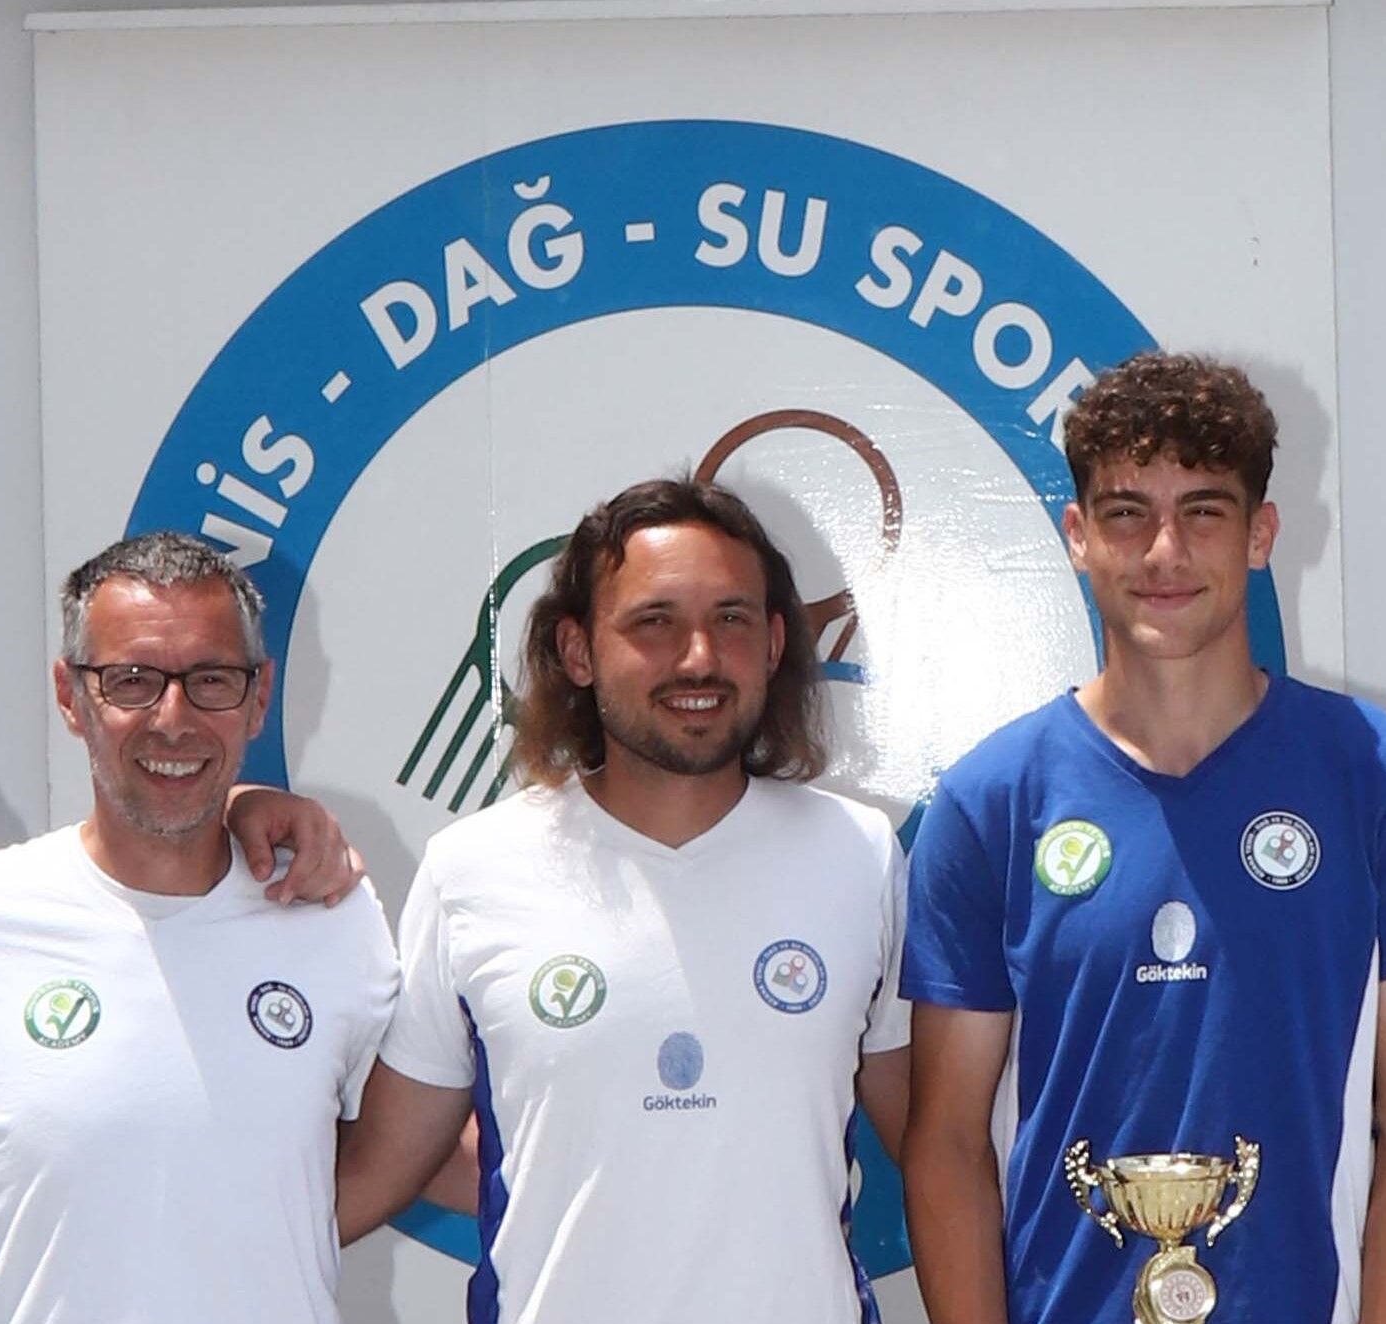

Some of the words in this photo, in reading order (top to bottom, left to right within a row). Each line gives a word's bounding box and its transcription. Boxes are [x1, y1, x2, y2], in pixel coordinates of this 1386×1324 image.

[359, 175, 584, 370] DAĞ
[694, 182, 828, 277] SU
[1135, 963, 1208, 985] Göktekin
[642, 1093, 717, 1112] Göktekin
